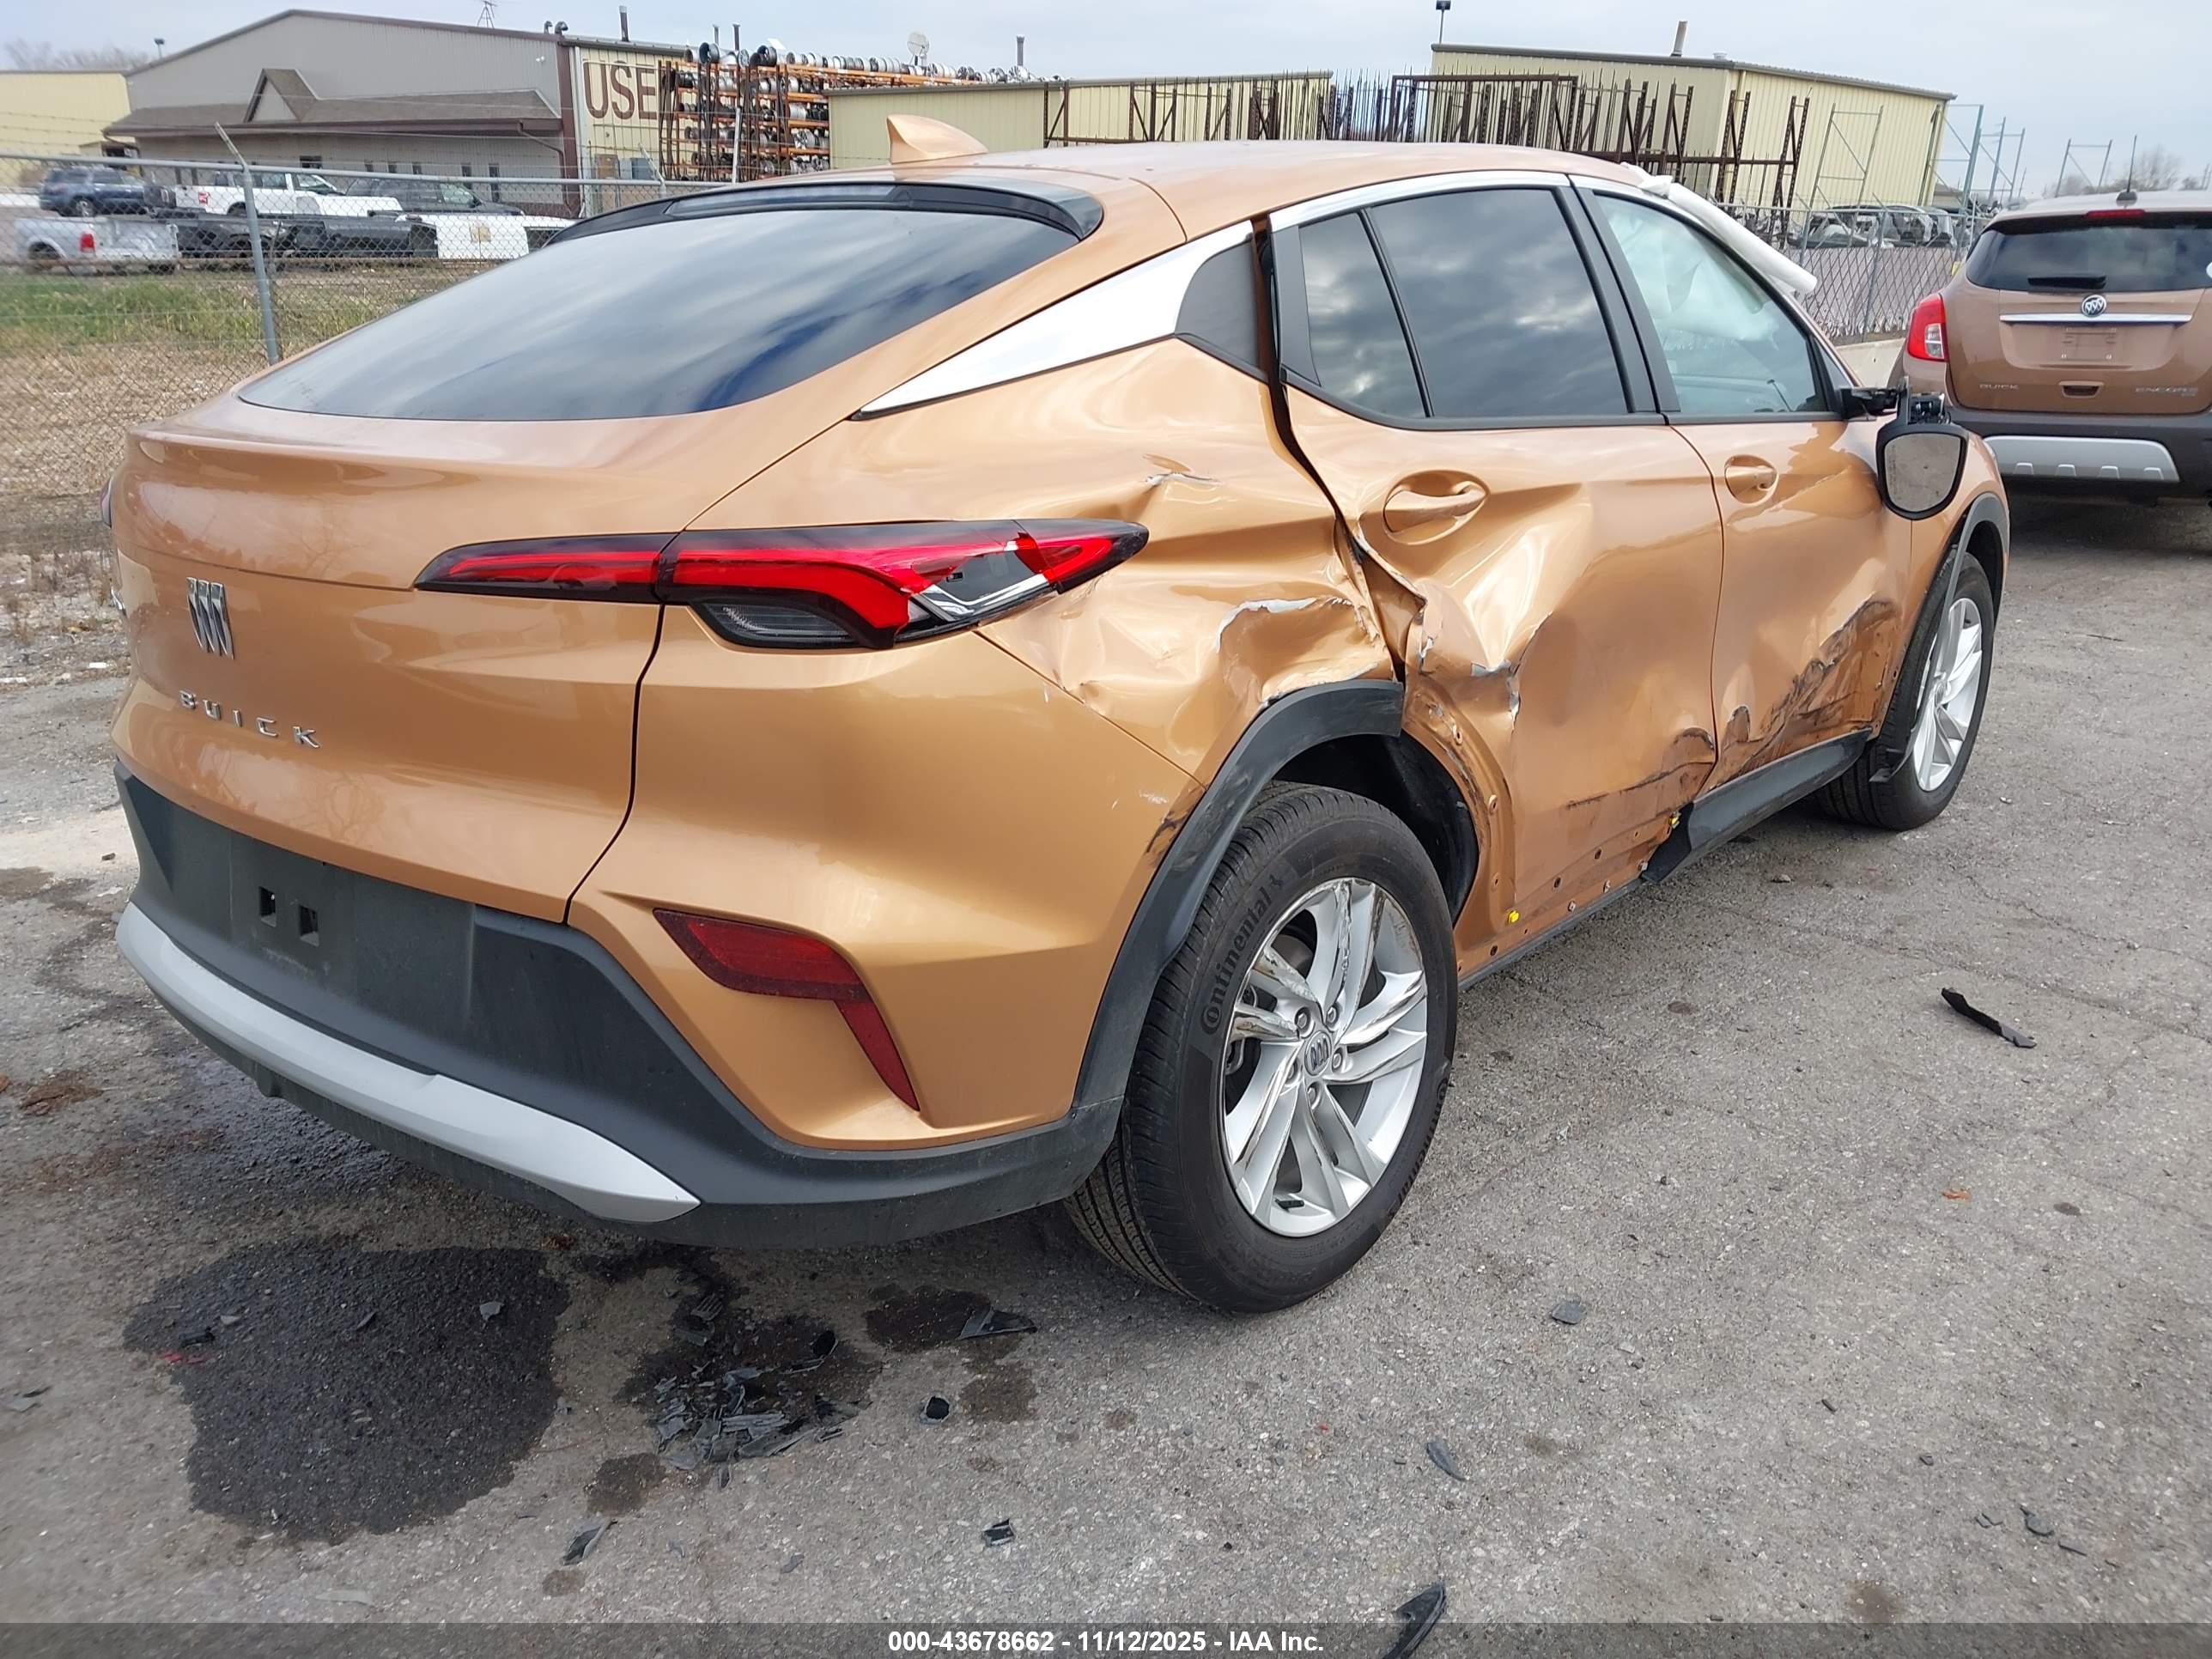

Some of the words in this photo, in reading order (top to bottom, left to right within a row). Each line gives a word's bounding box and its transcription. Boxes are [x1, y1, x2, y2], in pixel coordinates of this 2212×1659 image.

[583, 59, 658, 120] USE
[179, 690, 320, 749] BUICK
[1202, 886, 1272, 1034] Continental
